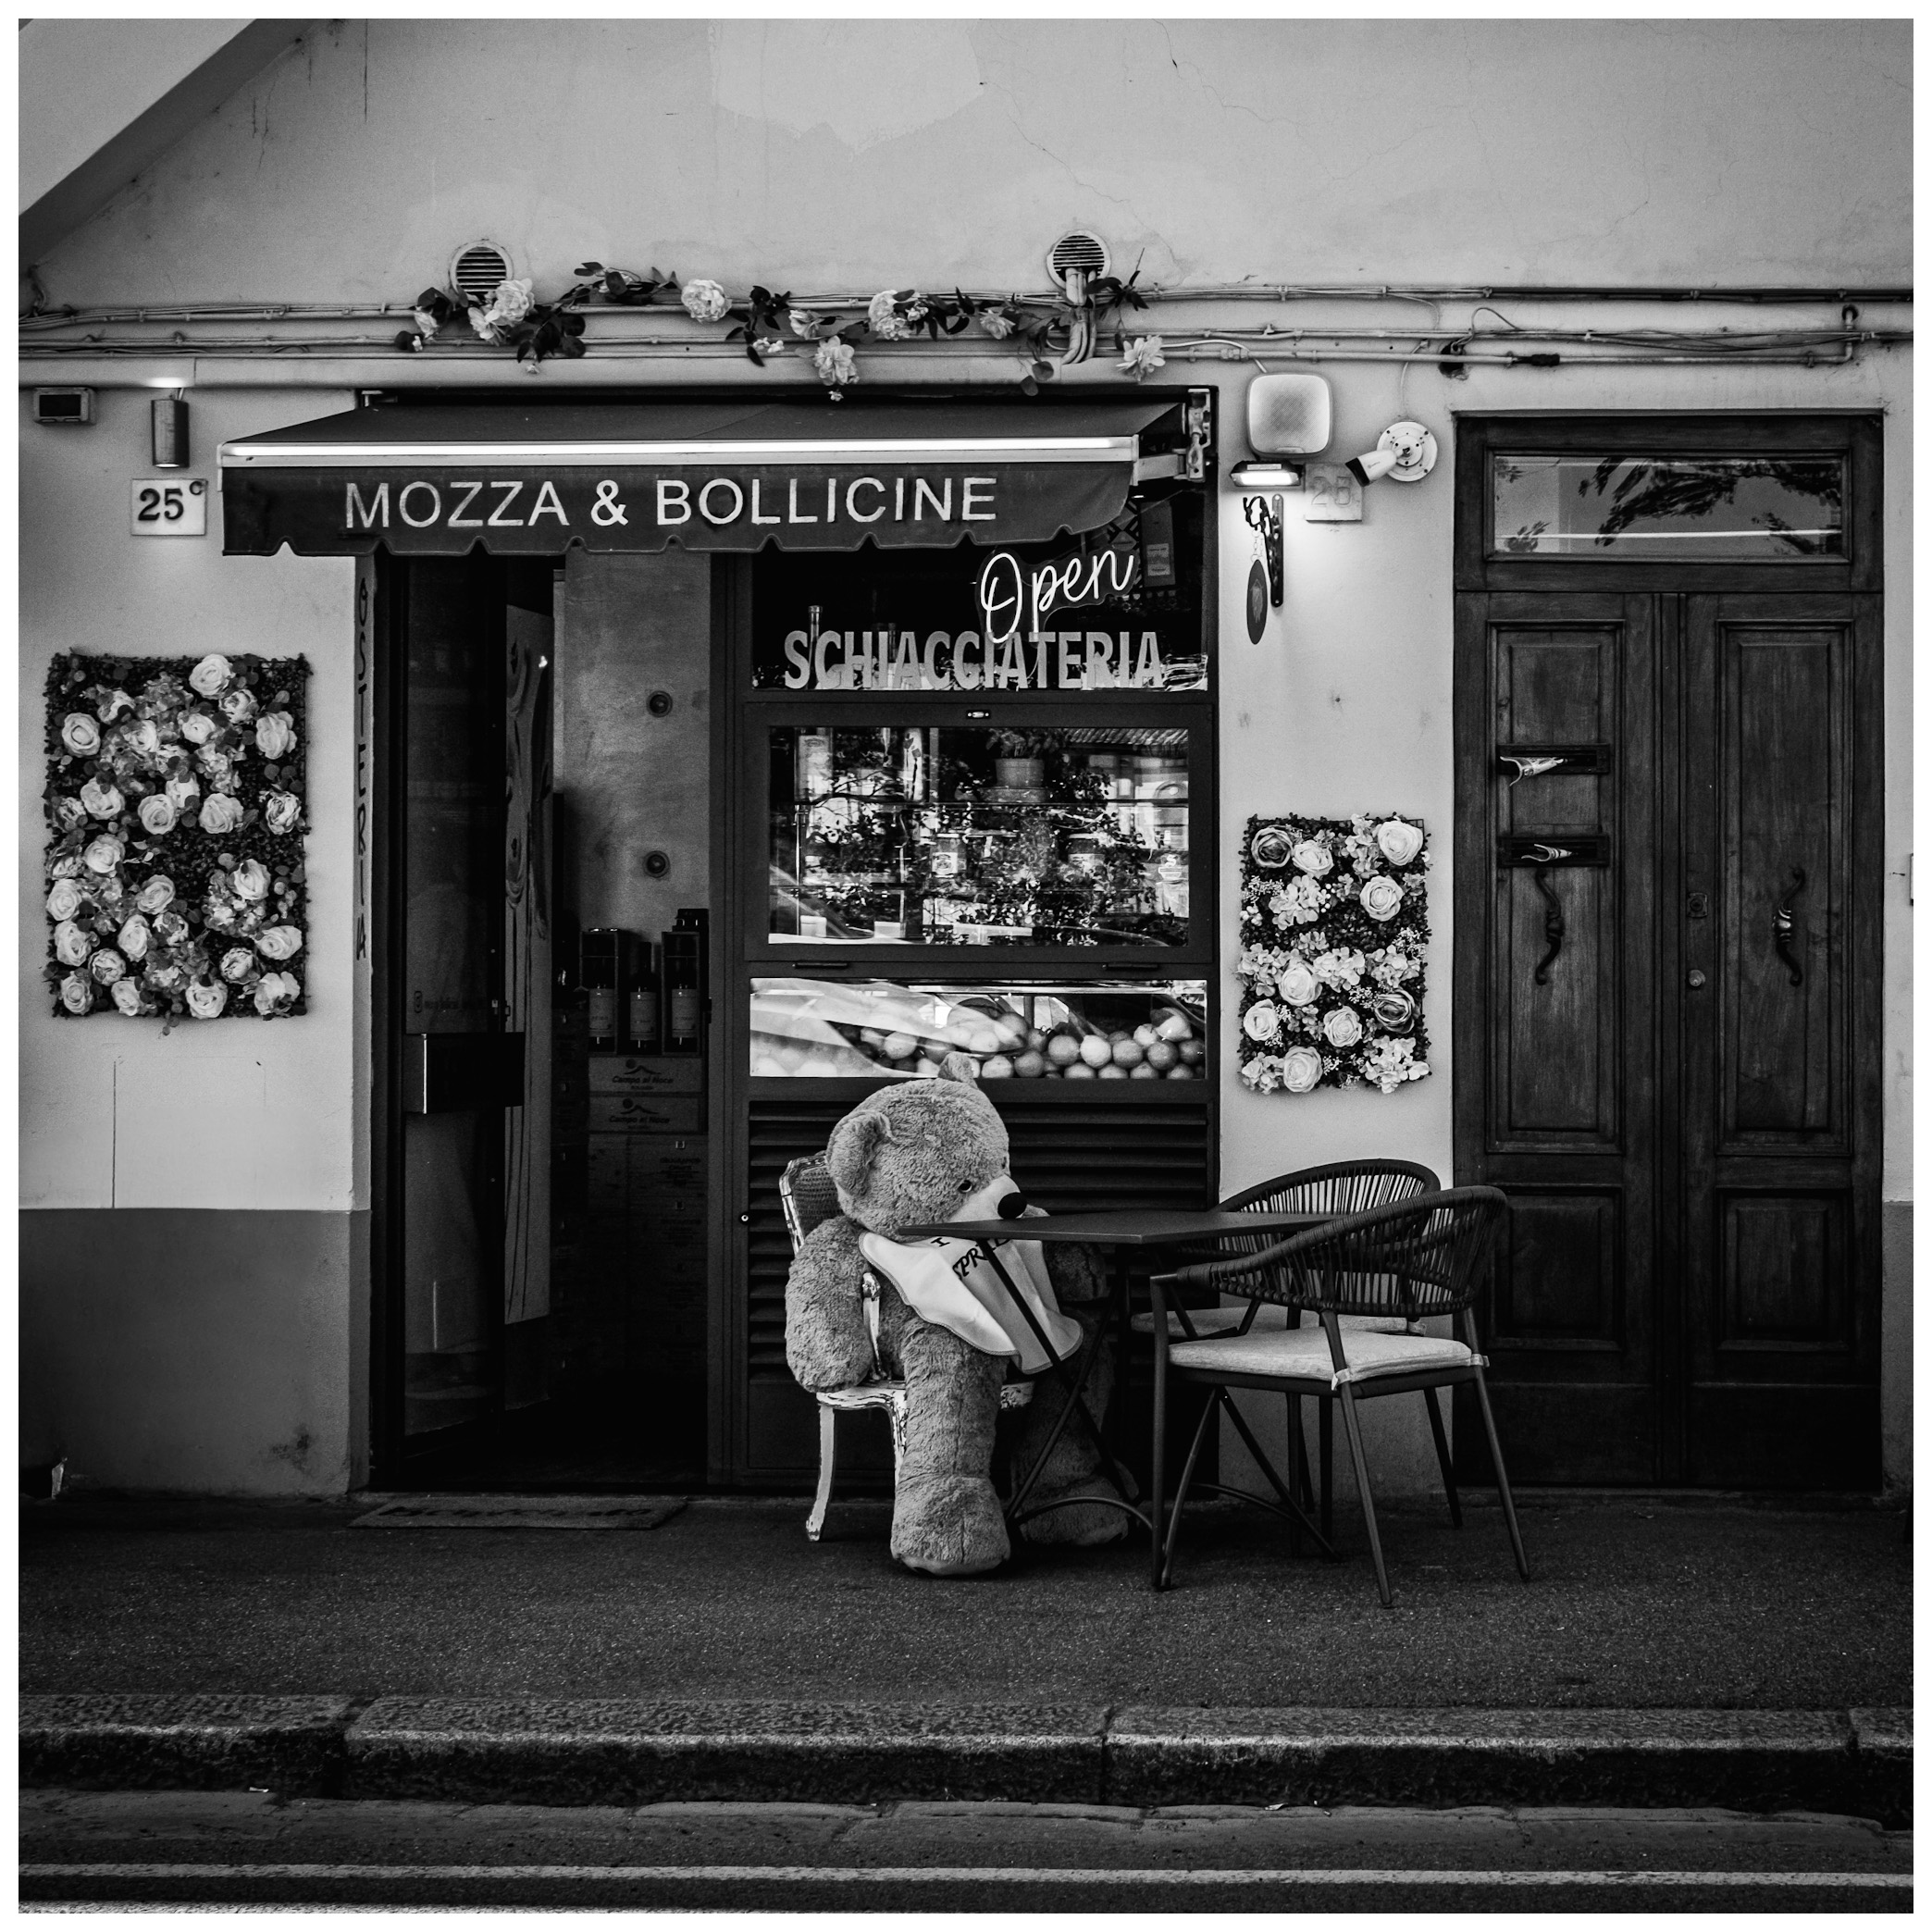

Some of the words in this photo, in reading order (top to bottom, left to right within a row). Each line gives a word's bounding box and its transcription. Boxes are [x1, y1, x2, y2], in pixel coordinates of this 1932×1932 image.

[345, 480, 570, 528] MOZZA
[590, 479, 628, 526] &
[656, 477, 997, 526] BOLLICINE
[980, 550, 1134, 644] Open
[783, 629, 1165, 690] SCHIACCIATERIA
[357, 576, 368, 961] OSTERIA
